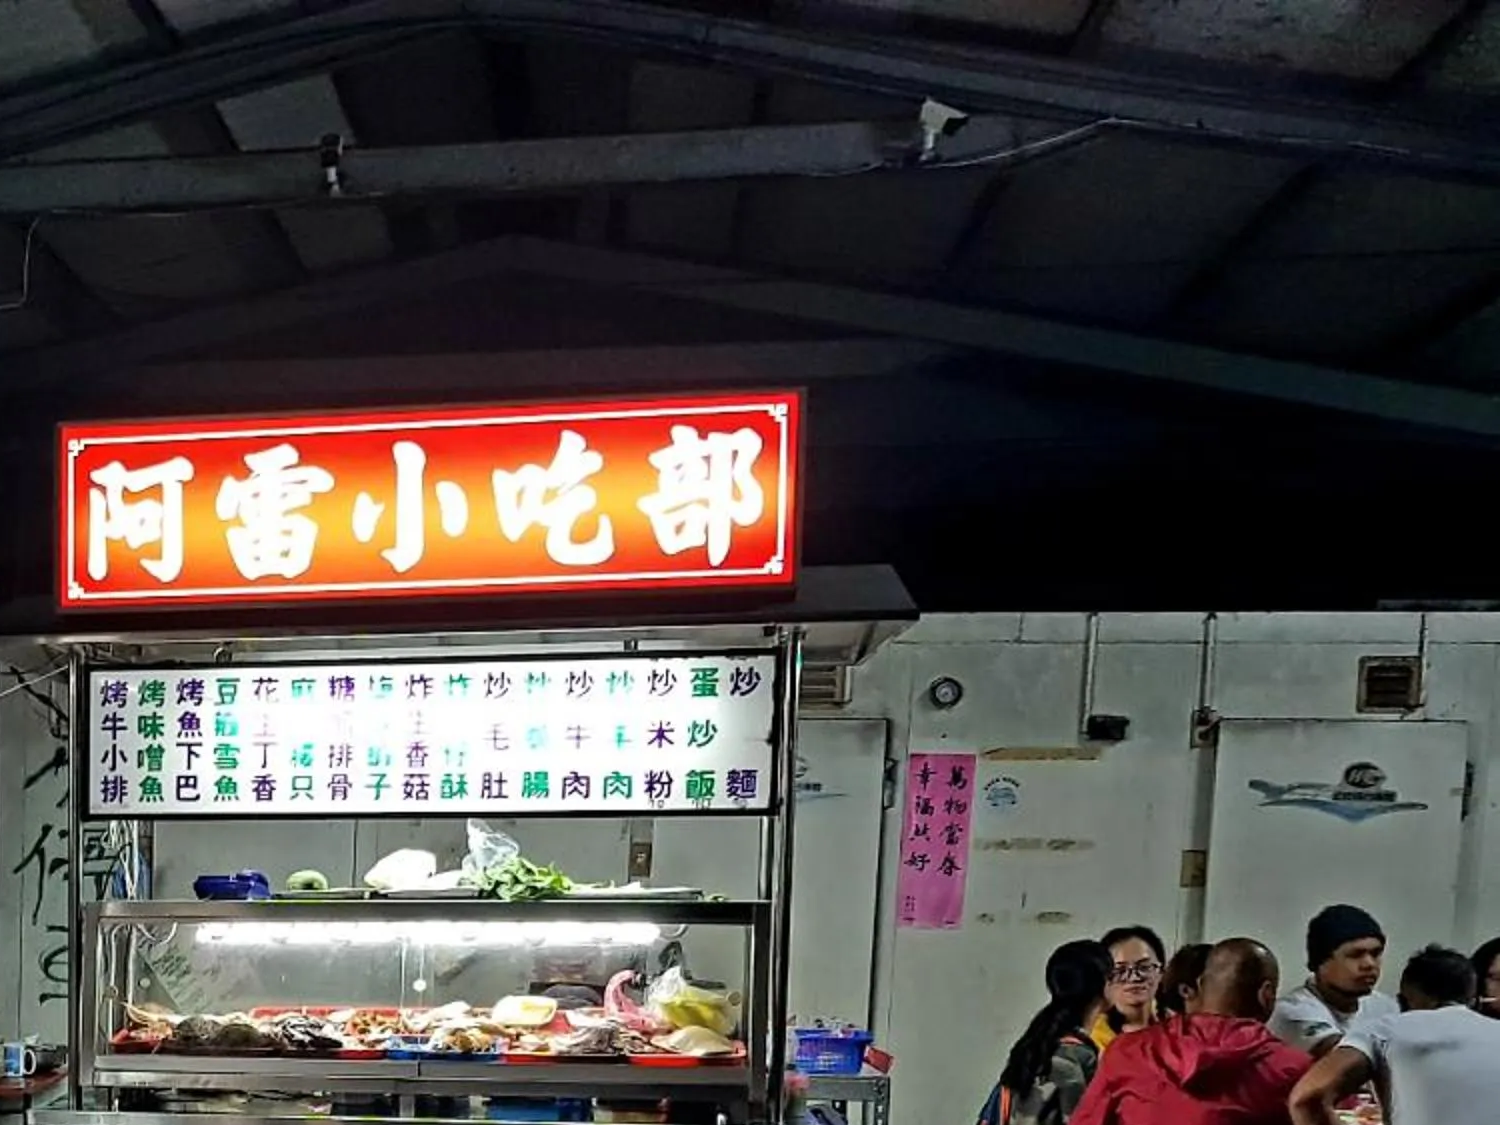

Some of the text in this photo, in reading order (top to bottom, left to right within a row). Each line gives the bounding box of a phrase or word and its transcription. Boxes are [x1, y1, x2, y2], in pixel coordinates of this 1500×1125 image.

[87, 424, 764, 583] 阿雷小吃部
[100, 681, 128, 803] 烤牛小排
[138, 680, 166, 802] 烤味噌魚
[176, 679, 204, 801] 烤魚下巴
[327, 675, 355, 800] 糖排骨
[480, 672, 511, 799] 炒毛肚
[561, 670, 594, 800] 炒牛肉
[644, 668, 677, 802] 炒米粉
[686, 668, 719, 801] 蛋炒飯
[727, 666, 761, 801] 炒麵
